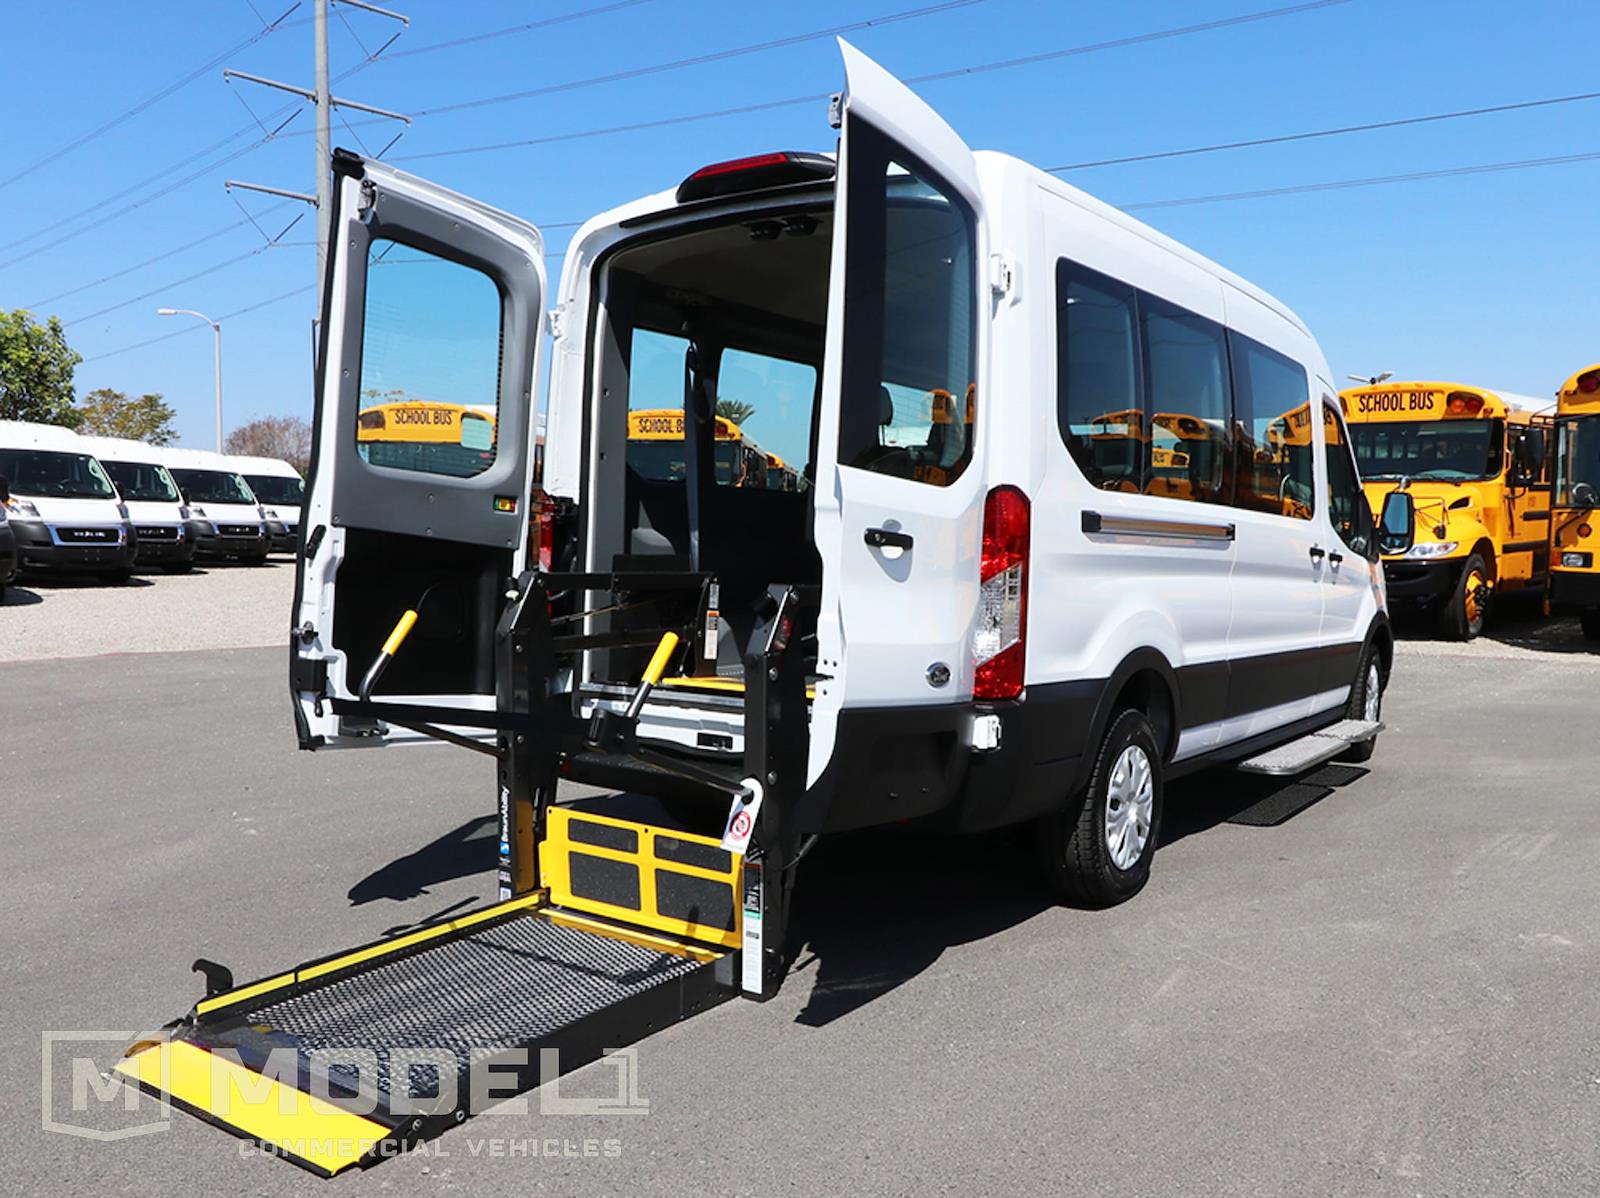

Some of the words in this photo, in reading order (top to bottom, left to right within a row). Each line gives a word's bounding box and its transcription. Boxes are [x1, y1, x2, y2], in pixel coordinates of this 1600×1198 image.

[1359, 392, 1406, 412] SCHOOL
[1409, 391, 1434, 410] BUS
[395, 409, 432, 425] SCHOOL
[433, 409, 452, 425] BUS
[639, 418, 674, 433] SCHOOL
